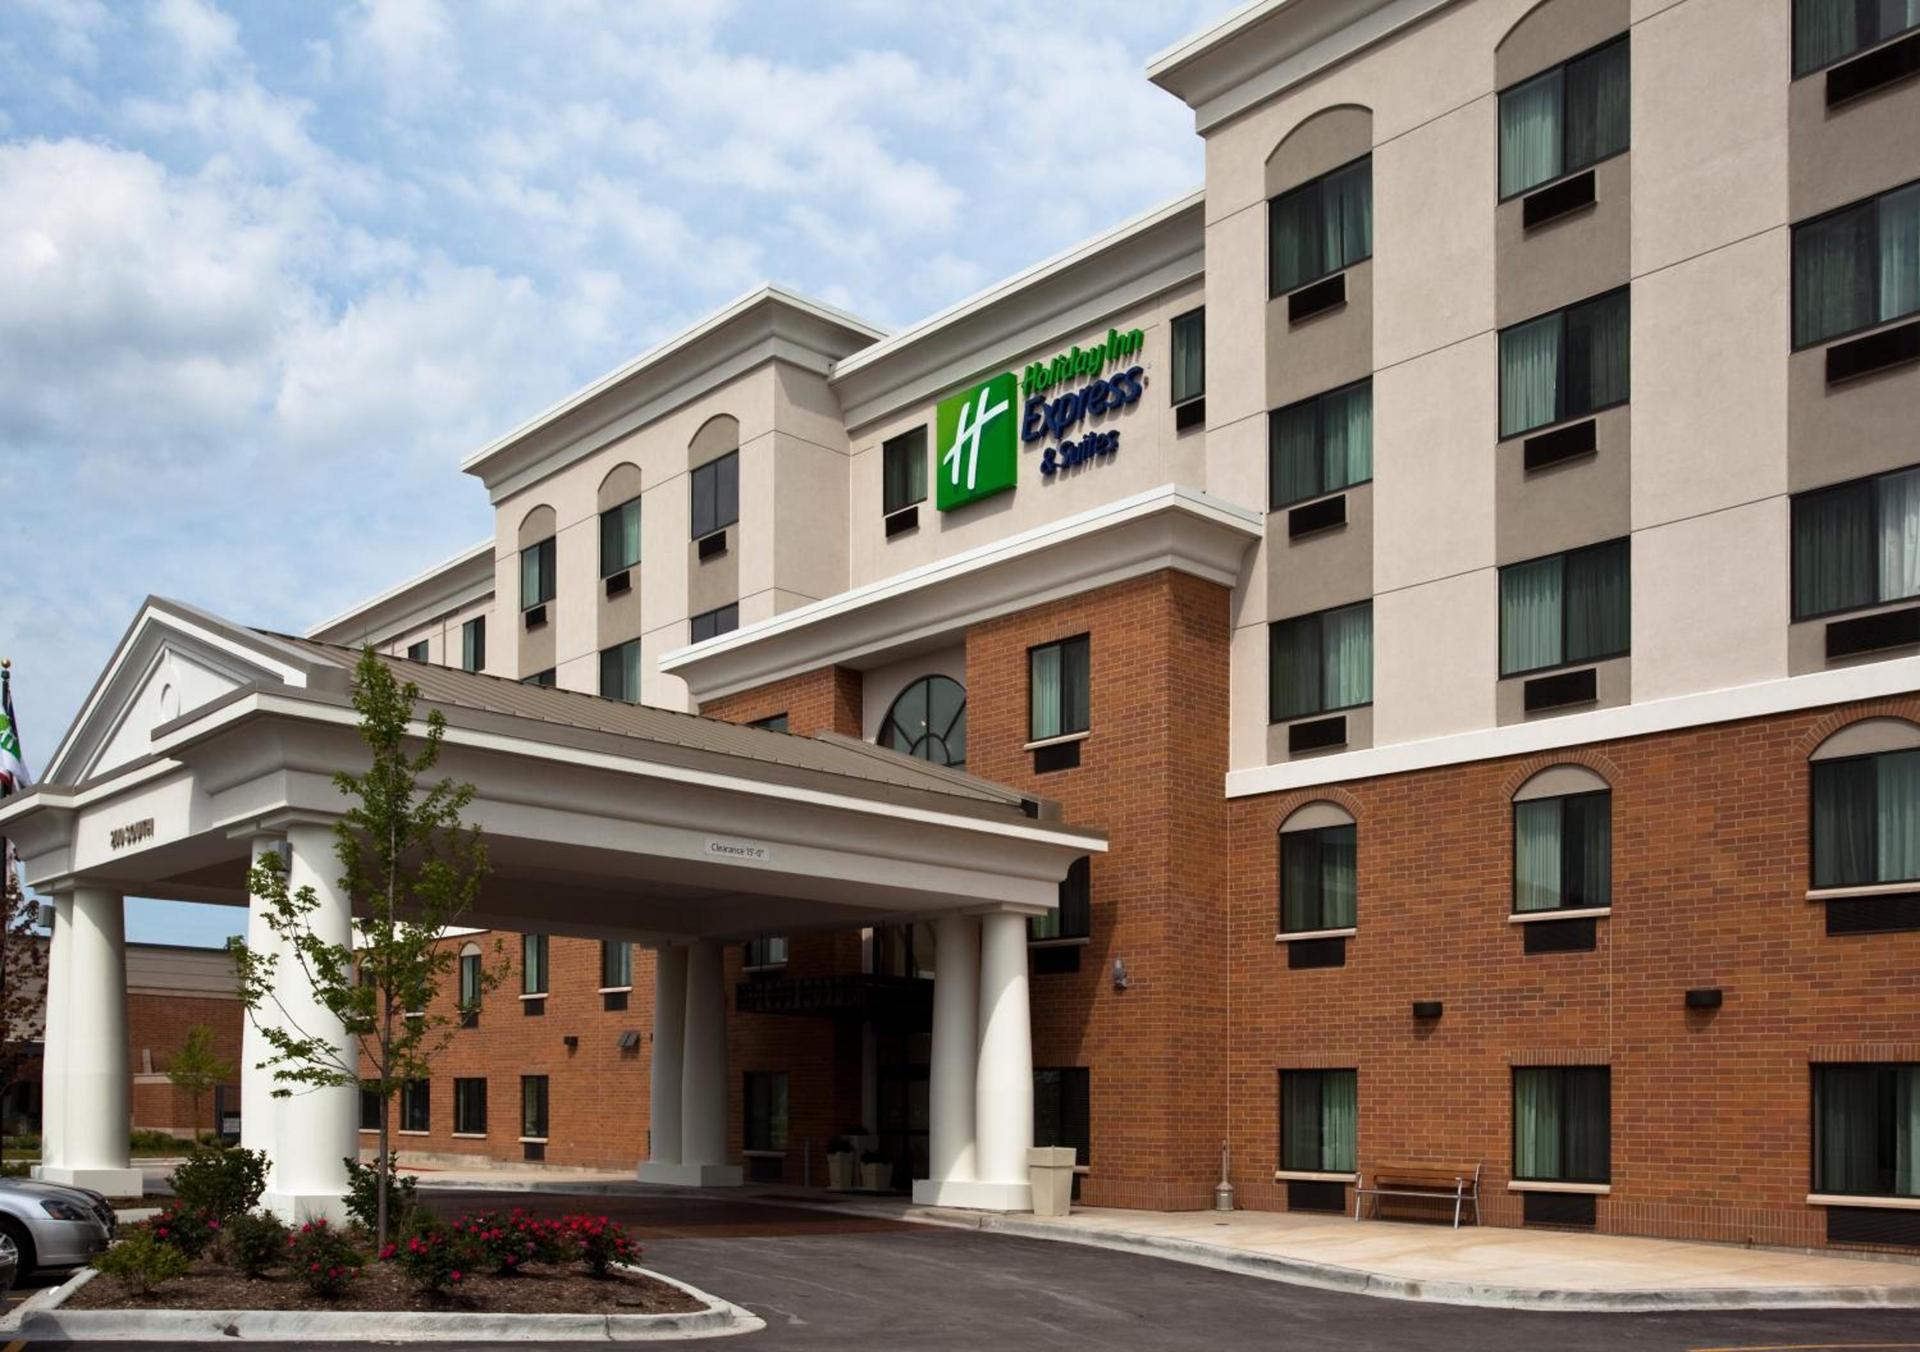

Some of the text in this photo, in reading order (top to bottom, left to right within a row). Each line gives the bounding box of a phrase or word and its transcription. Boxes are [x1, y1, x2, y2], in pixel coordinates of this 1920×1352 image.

[1022, 328, 1144, 396] Holiday Inn
[1021, 366, 1143, 442] Express
[1040, 429, 1120, 475] & Suites
[125, 817, 154, 846] SOUTH
[711, 843, 745, 855] Clearance
